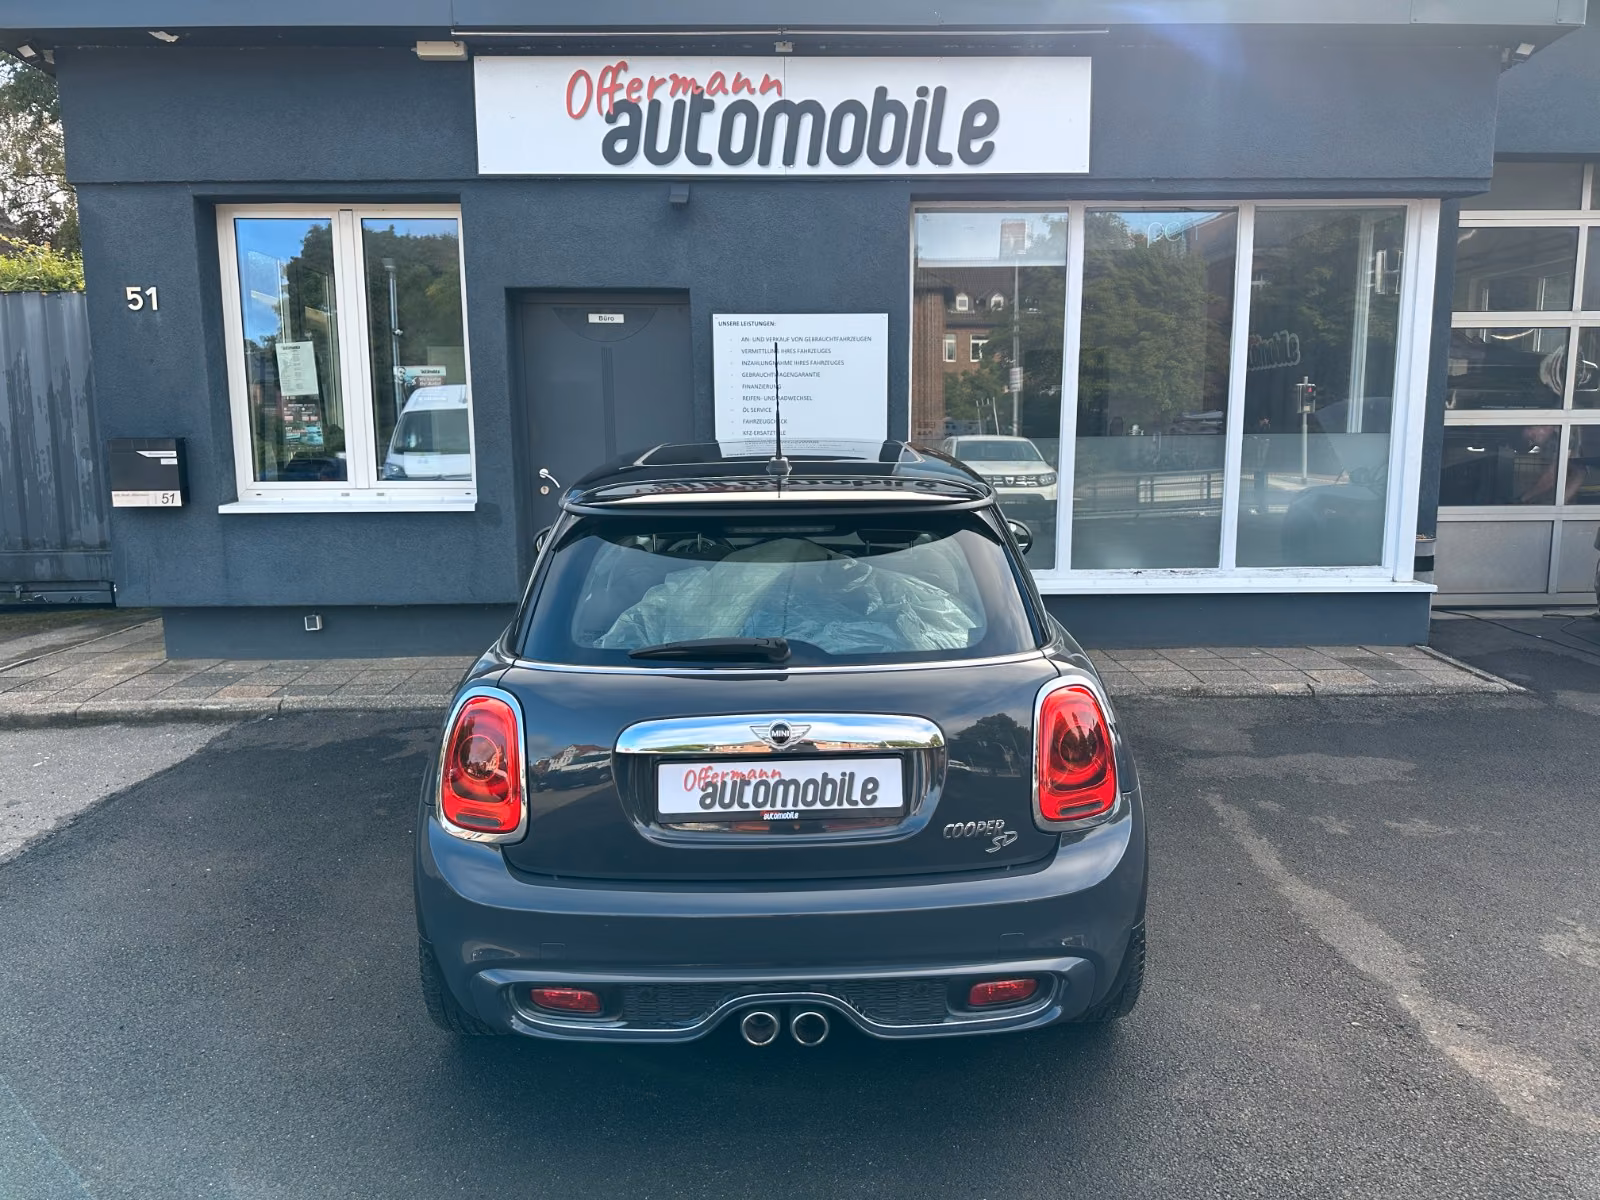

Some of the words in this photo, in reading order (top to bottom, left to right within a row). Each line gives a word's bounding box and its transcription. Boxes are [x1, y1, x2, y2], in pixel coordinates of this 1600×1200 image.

[566, 61, 783, 120] Offermann
[602, 85, 1000, 167] automobile
[125, 286, 159, 311] 51
[161, 493, 175, 504] 51
[684, 766, 782, 792] Offermann
[699, 772, 880, 810] automobile
[763, 811, 799, 820] automobile
[943, 819, 1005, 839] COOPER
[985, 830, 1018, 853] SD
